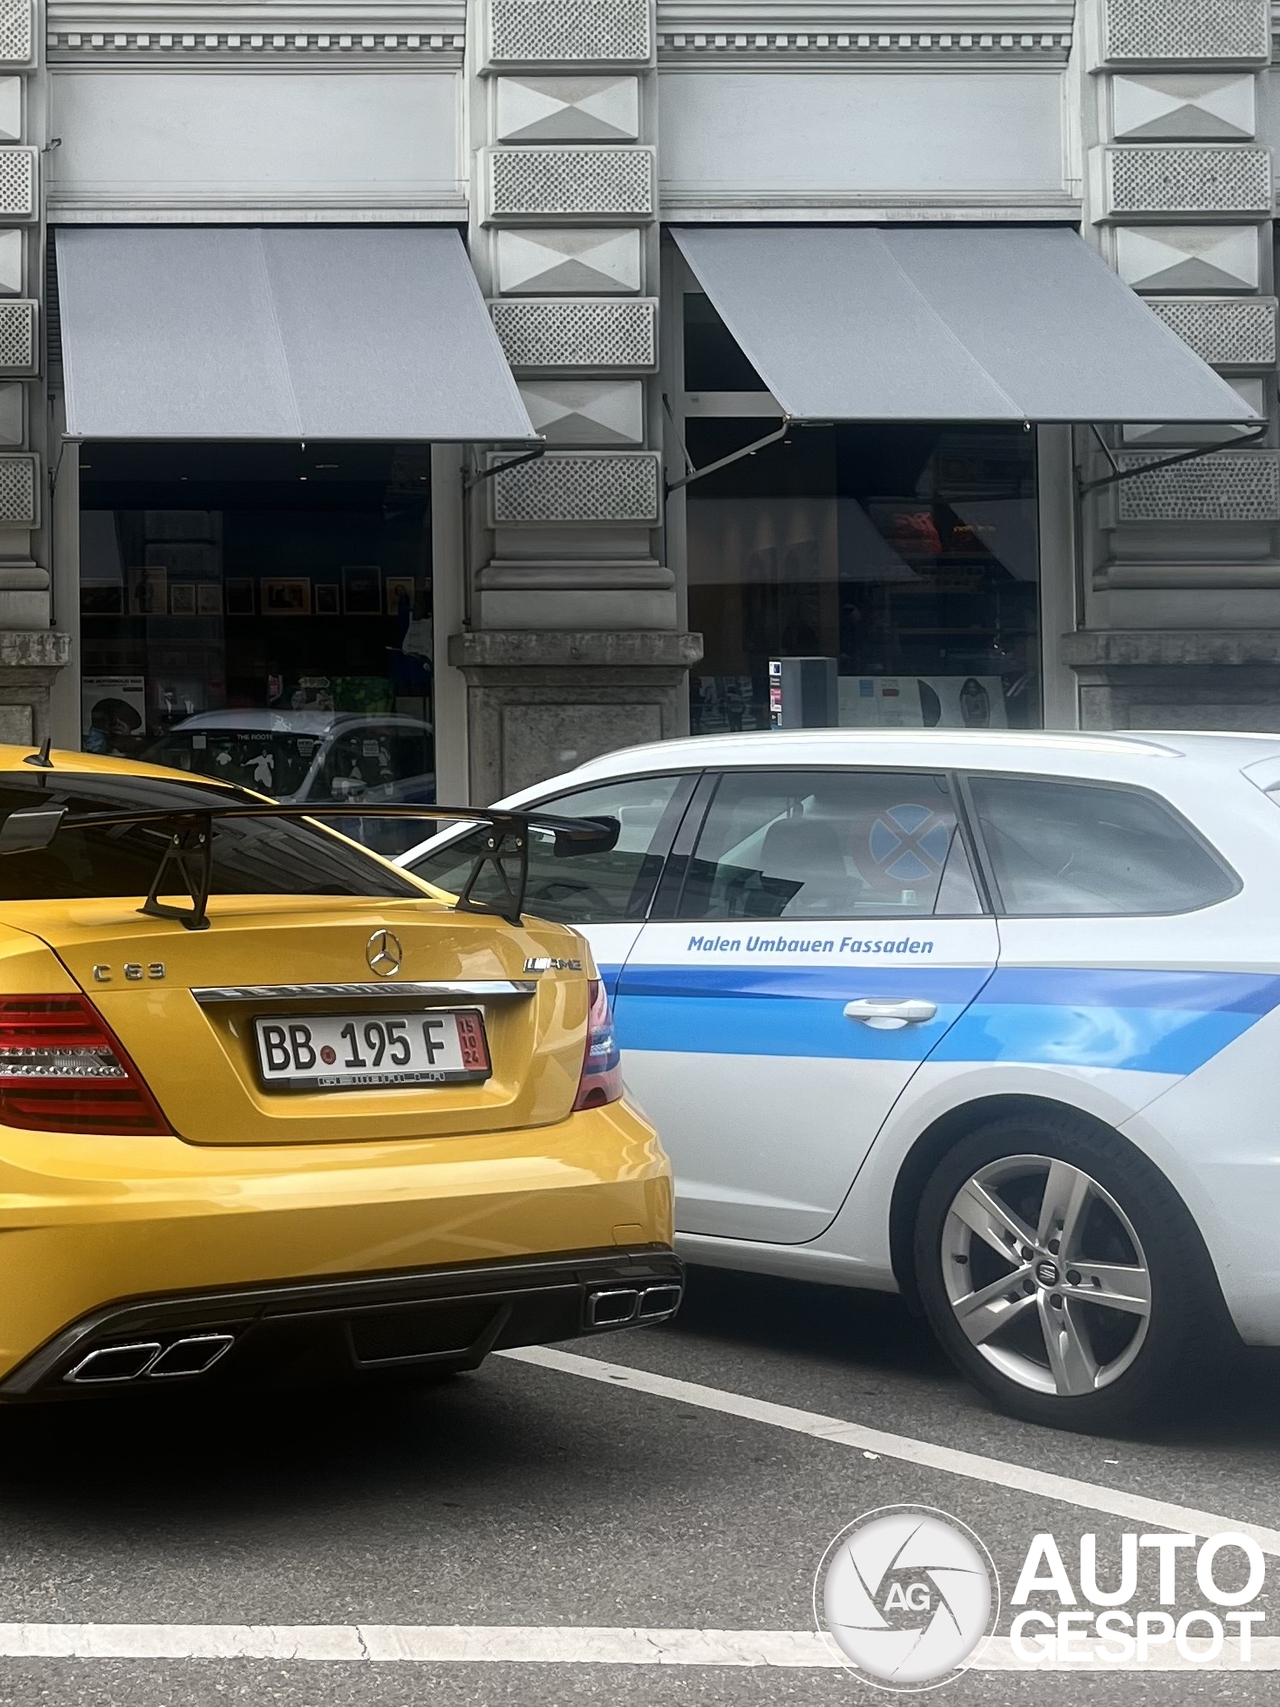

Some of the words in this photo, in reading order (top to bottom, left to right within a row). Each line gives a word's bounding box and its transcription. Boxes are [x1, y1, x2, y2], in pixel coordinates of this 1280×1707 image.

[237, 733, 250, 741] THE
[687, 936, 741, 952] Malen
[746, 936, 834, 953] Umbauen
[839, 936, 934, 954] Fassaden
[93, 963, 112, 982] C
[123, 961, 167, 981] 63
[263, 1025, 317, 1071] BB
[340, 1020, 412, 1068] 195
[422, 1019, 445, 1065] F
[461, 1033, 477, 1048] 10
[463, 1048, 480, 1064] 24
